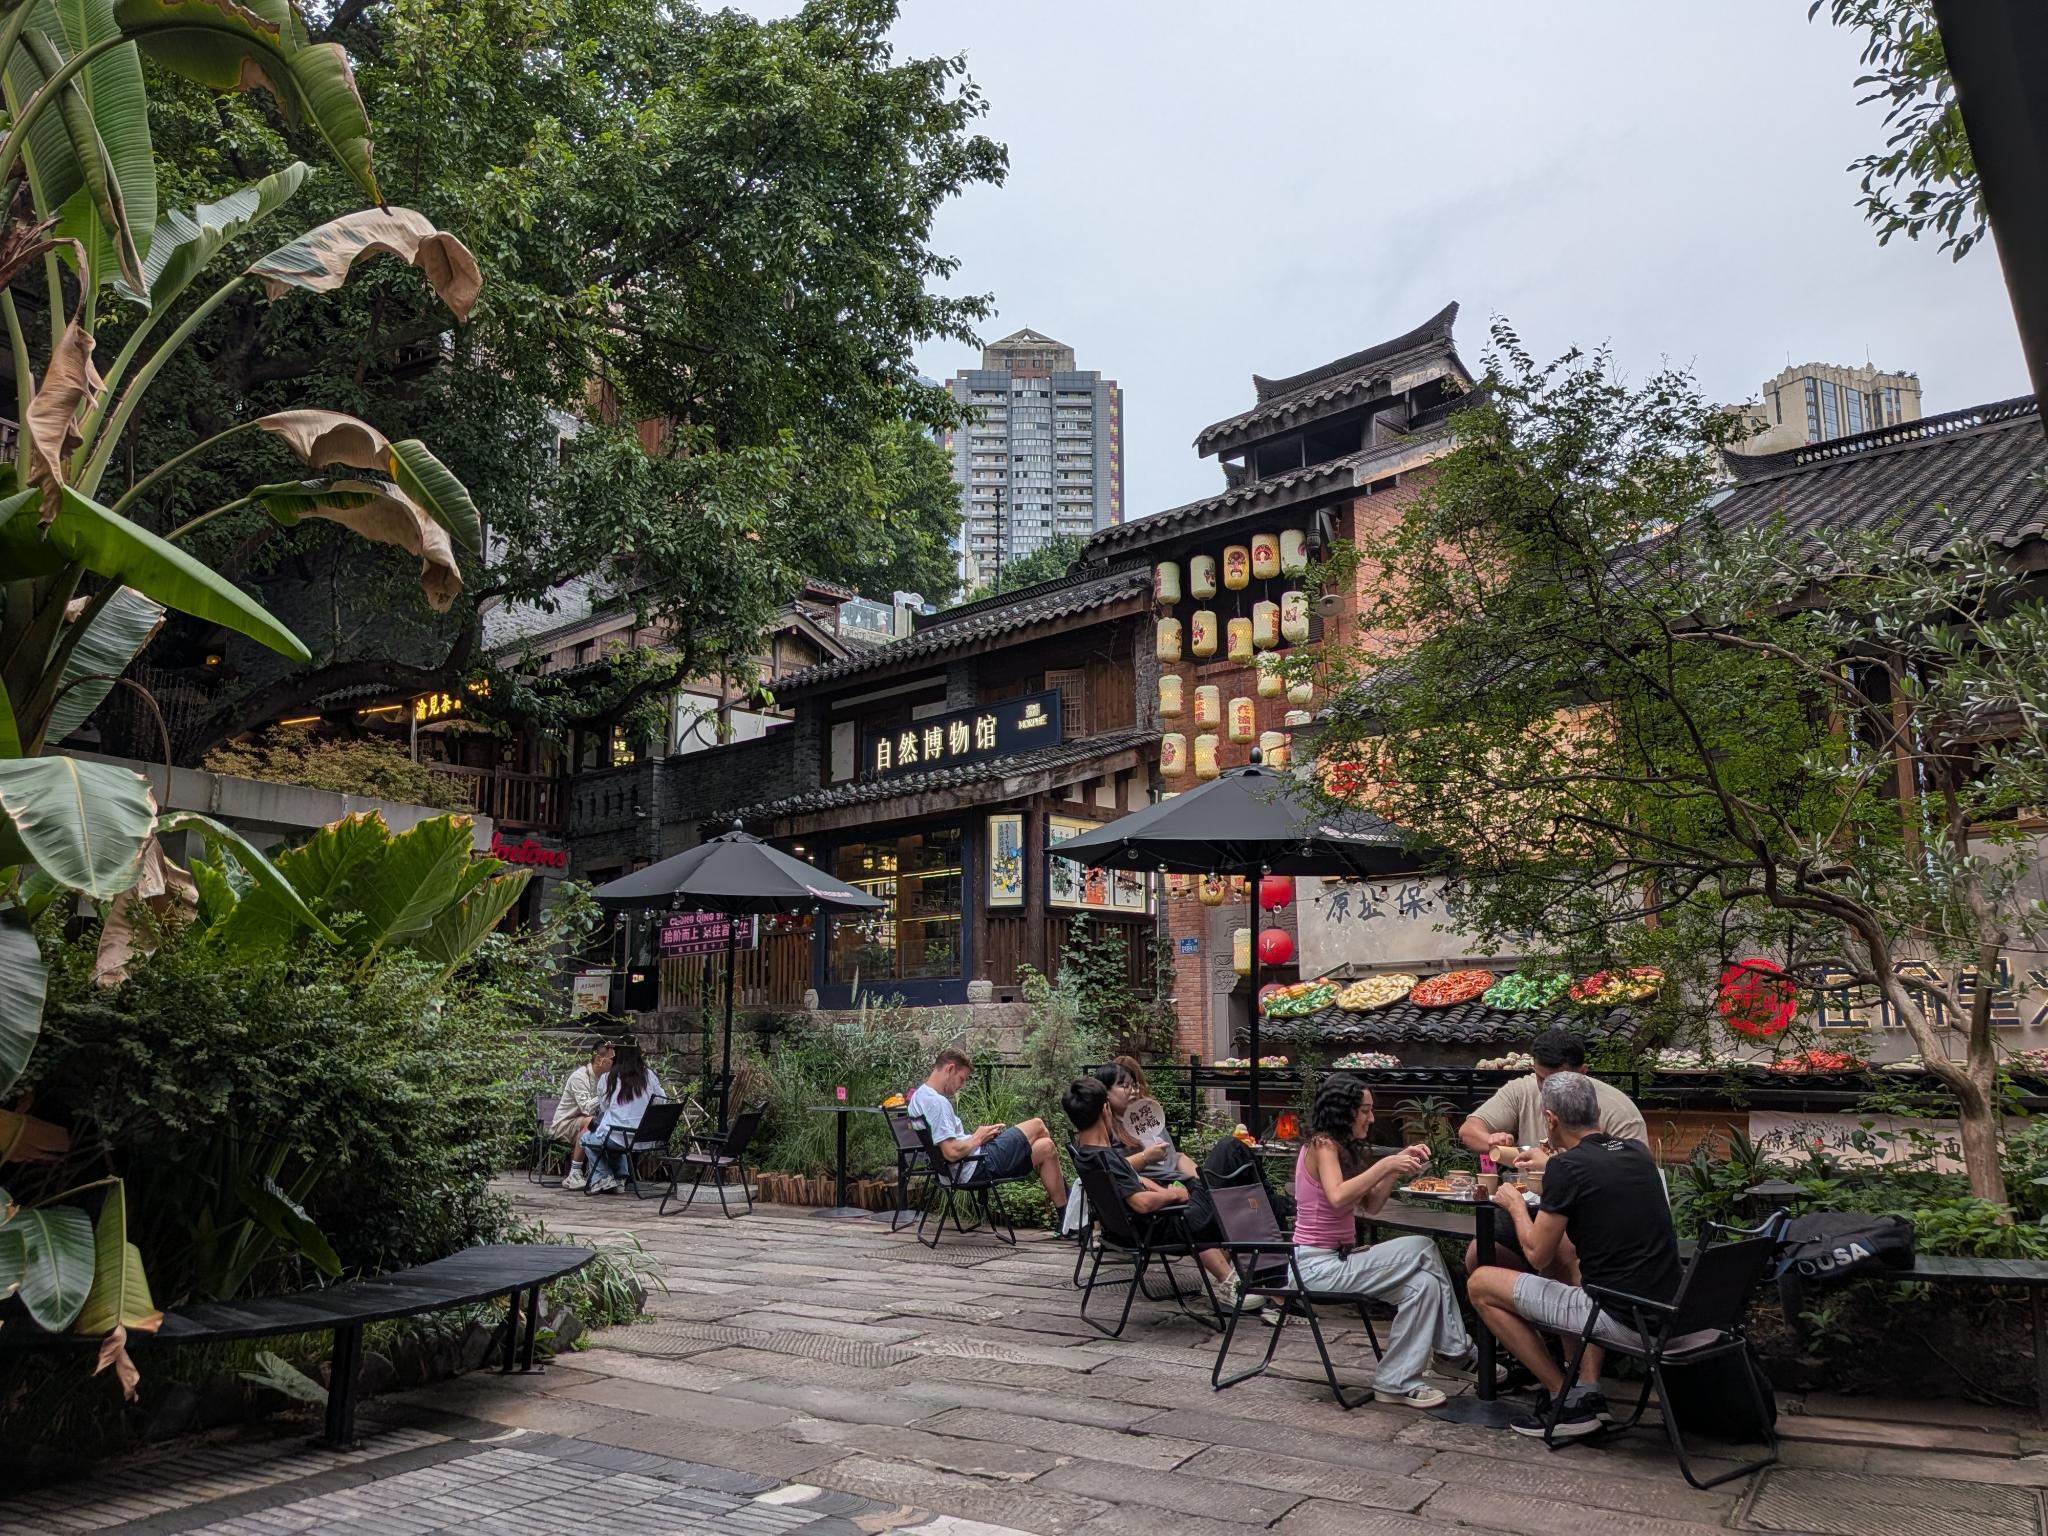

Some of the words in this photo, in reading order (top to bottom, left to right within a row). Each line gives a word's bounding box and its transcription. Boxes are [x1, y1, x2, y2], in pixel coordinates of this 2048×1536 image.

[877, 714, 998, 771] 自然博物馆
